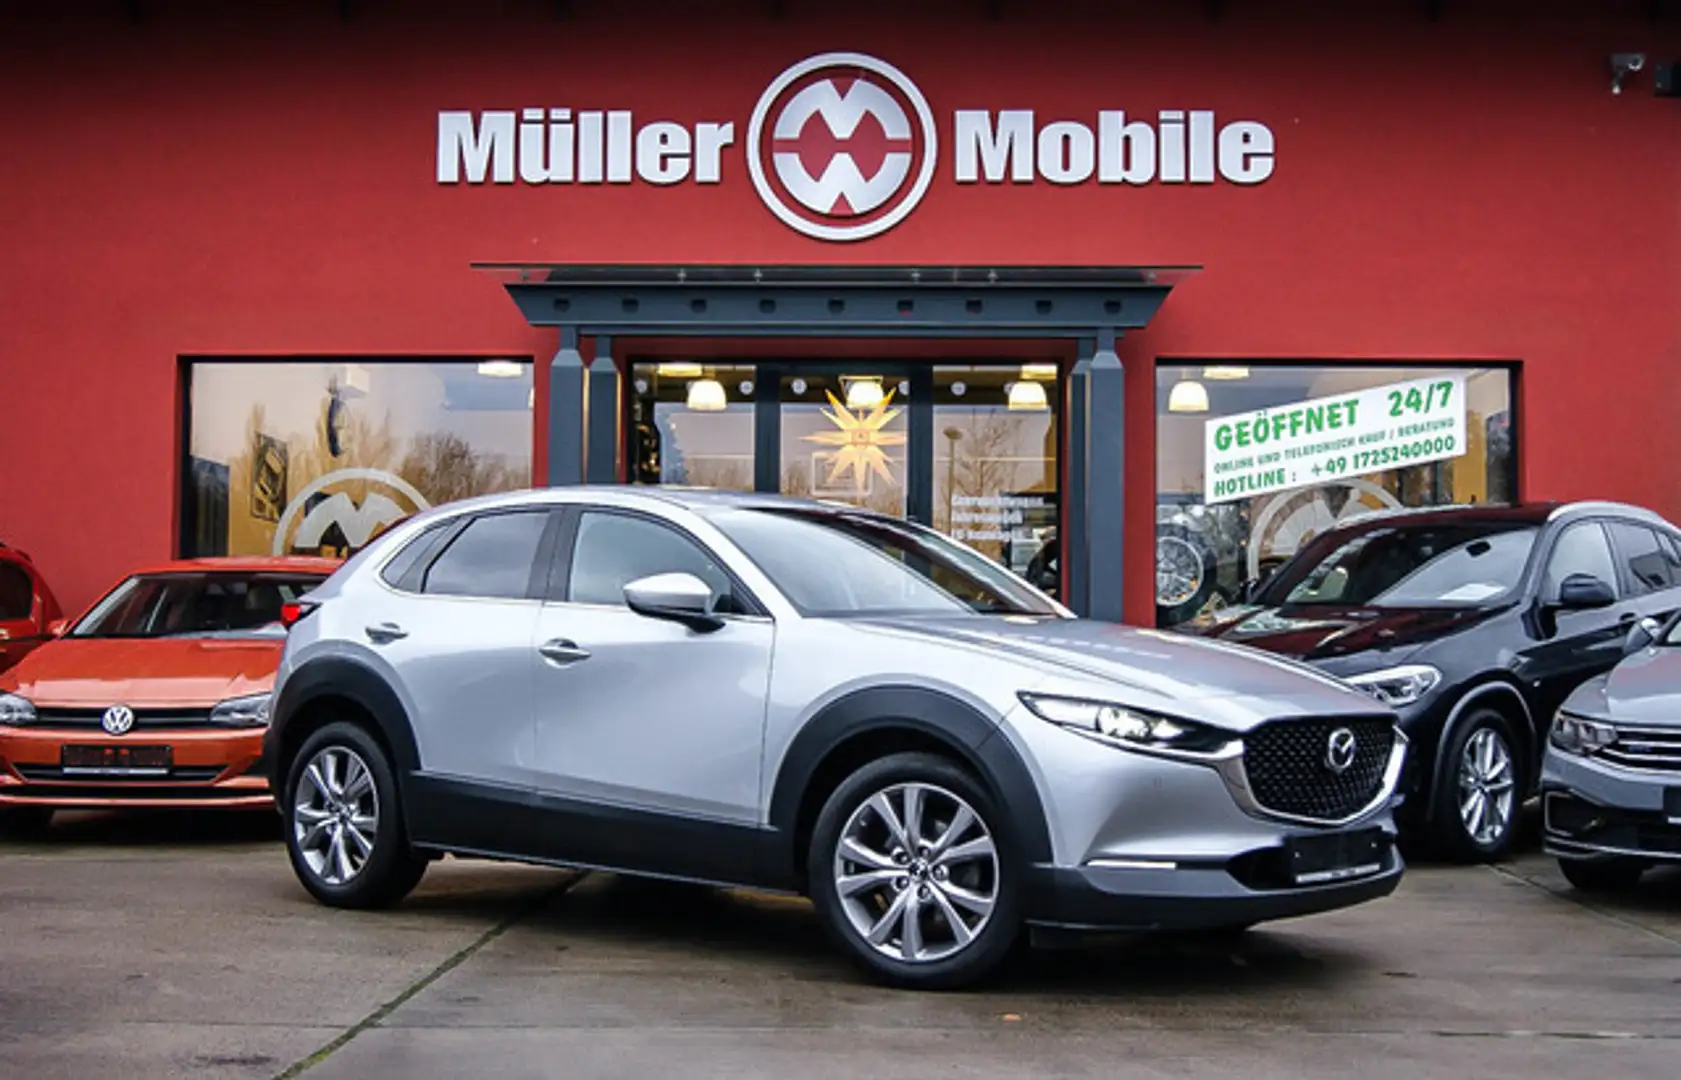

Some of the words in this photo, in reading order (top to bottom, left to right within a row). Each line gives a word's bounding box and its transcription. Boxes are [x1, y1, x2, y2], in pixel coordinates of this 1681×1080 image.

[436, 109, 734, 184] Müller
[954, 109, 1275, 184] Mobile
[1214, 399, 1359, 451] GEÖFFNET
[1388, 381, 1453, 417] 24/7
[1214, 467, 1286, 497] HOTLINE
[1311, 456, 1347, 476] +49
[1353, 435, 1454, 469] 1725240000
[1258, 452, 1281, 464] UND
